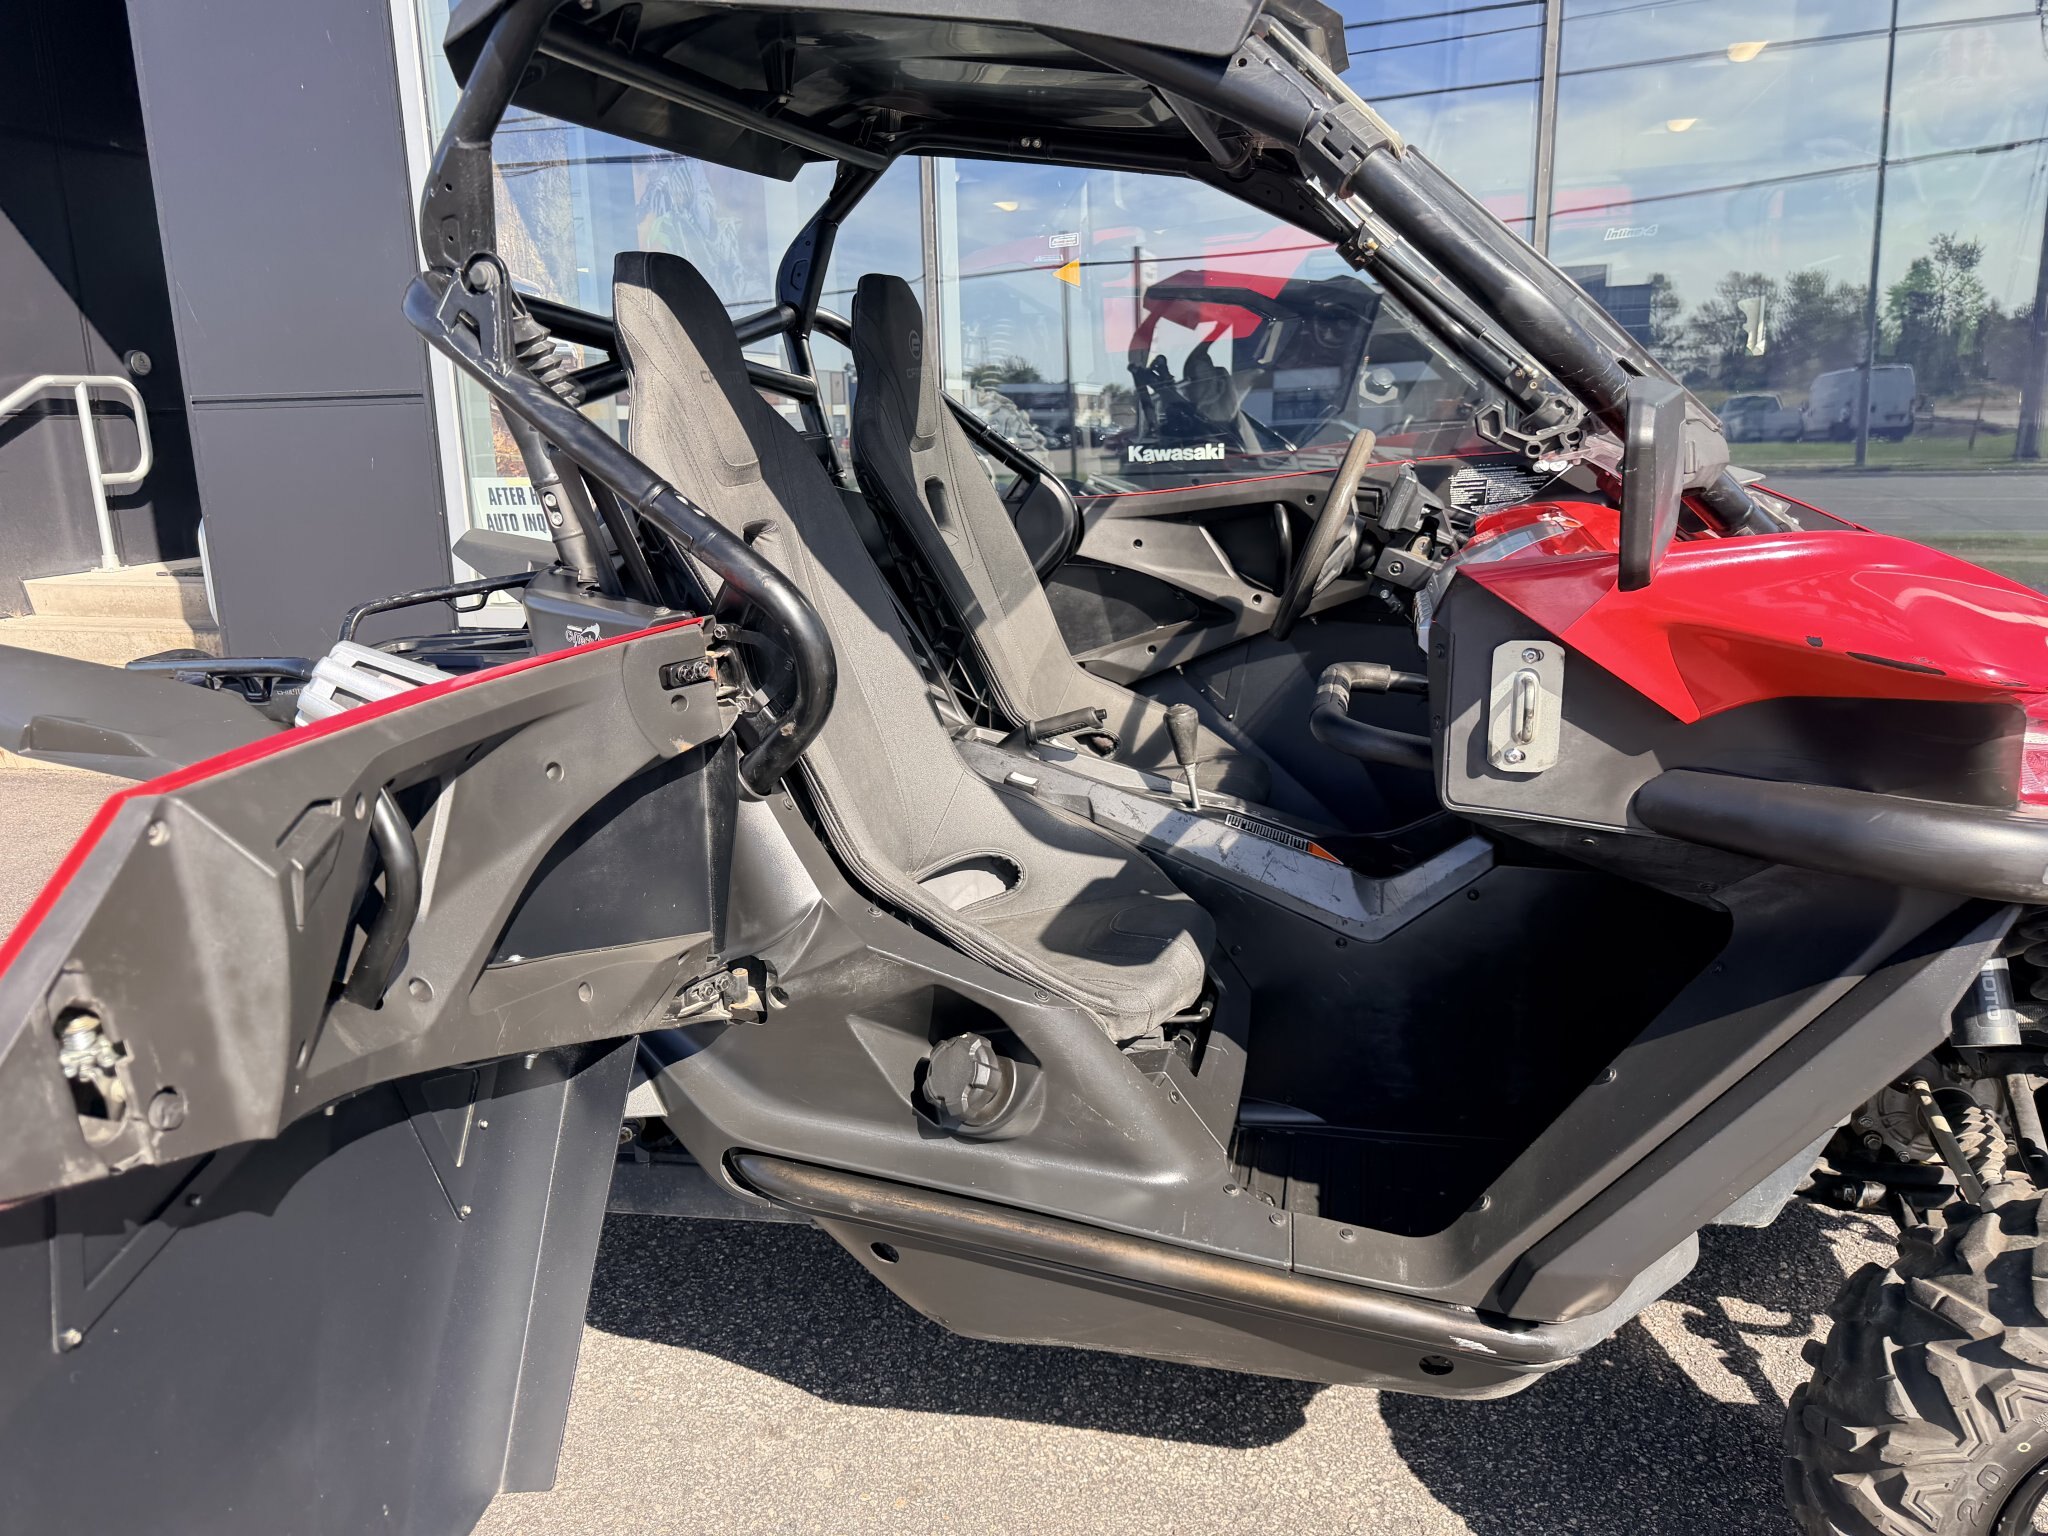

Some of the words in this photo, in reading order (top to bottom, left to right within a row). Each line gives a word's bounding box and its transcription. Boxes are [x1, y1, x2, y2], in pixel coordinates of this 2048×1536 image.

[1127, 442, 1225, 463] Kawasaki
[488, 487, 527, 506] AFTER
[529, 486, 541, 506] H
[486, 513, 520, 532] AUTO
[522, 513, 549, 534] INQ
